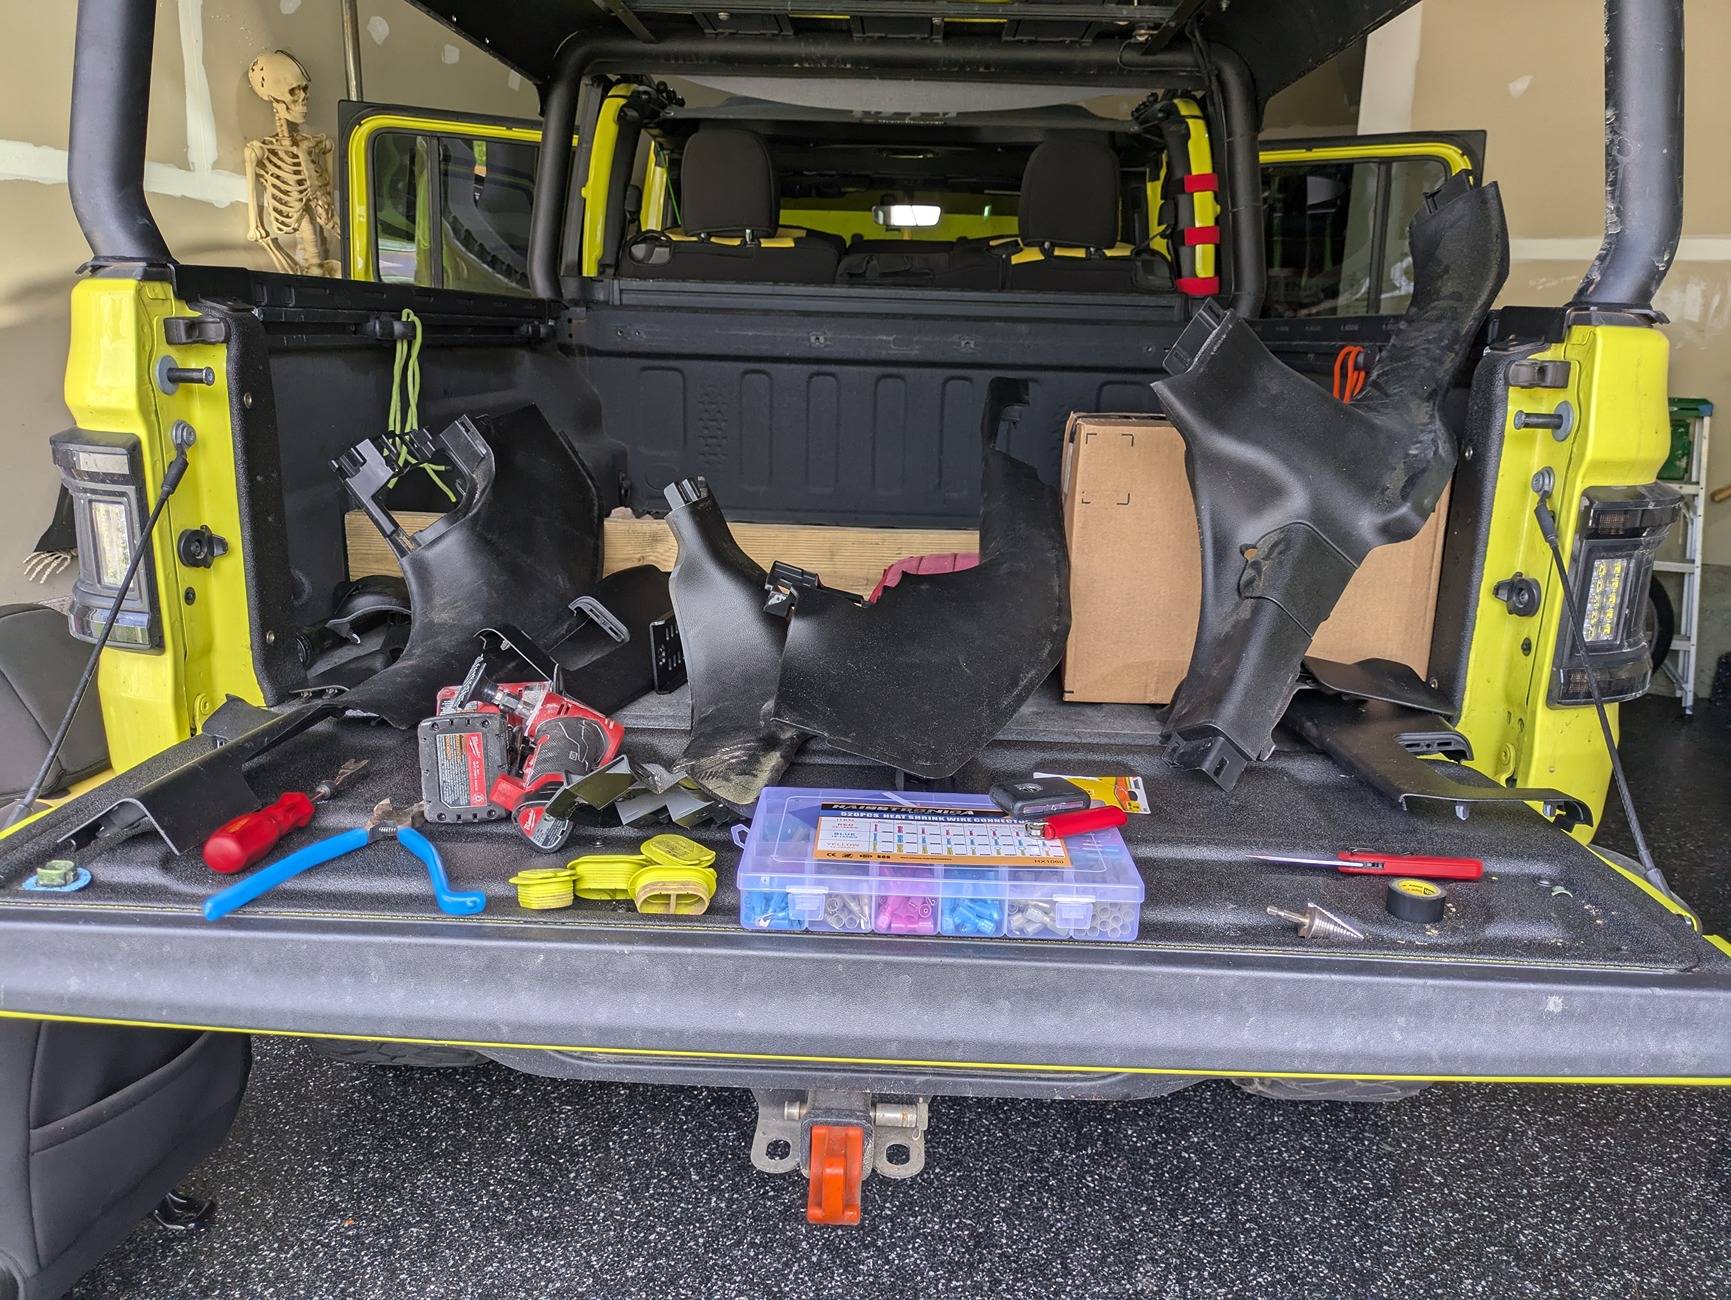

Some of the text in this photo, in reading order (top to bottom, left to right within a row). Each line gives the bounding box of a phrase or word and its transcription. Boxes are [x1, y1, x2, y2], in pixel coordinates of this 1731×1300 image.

[883, 812, 906, 820] HEAT
[908, 814, 945, 822] SHRINK
[946, 815, 974, 823] WIRE
